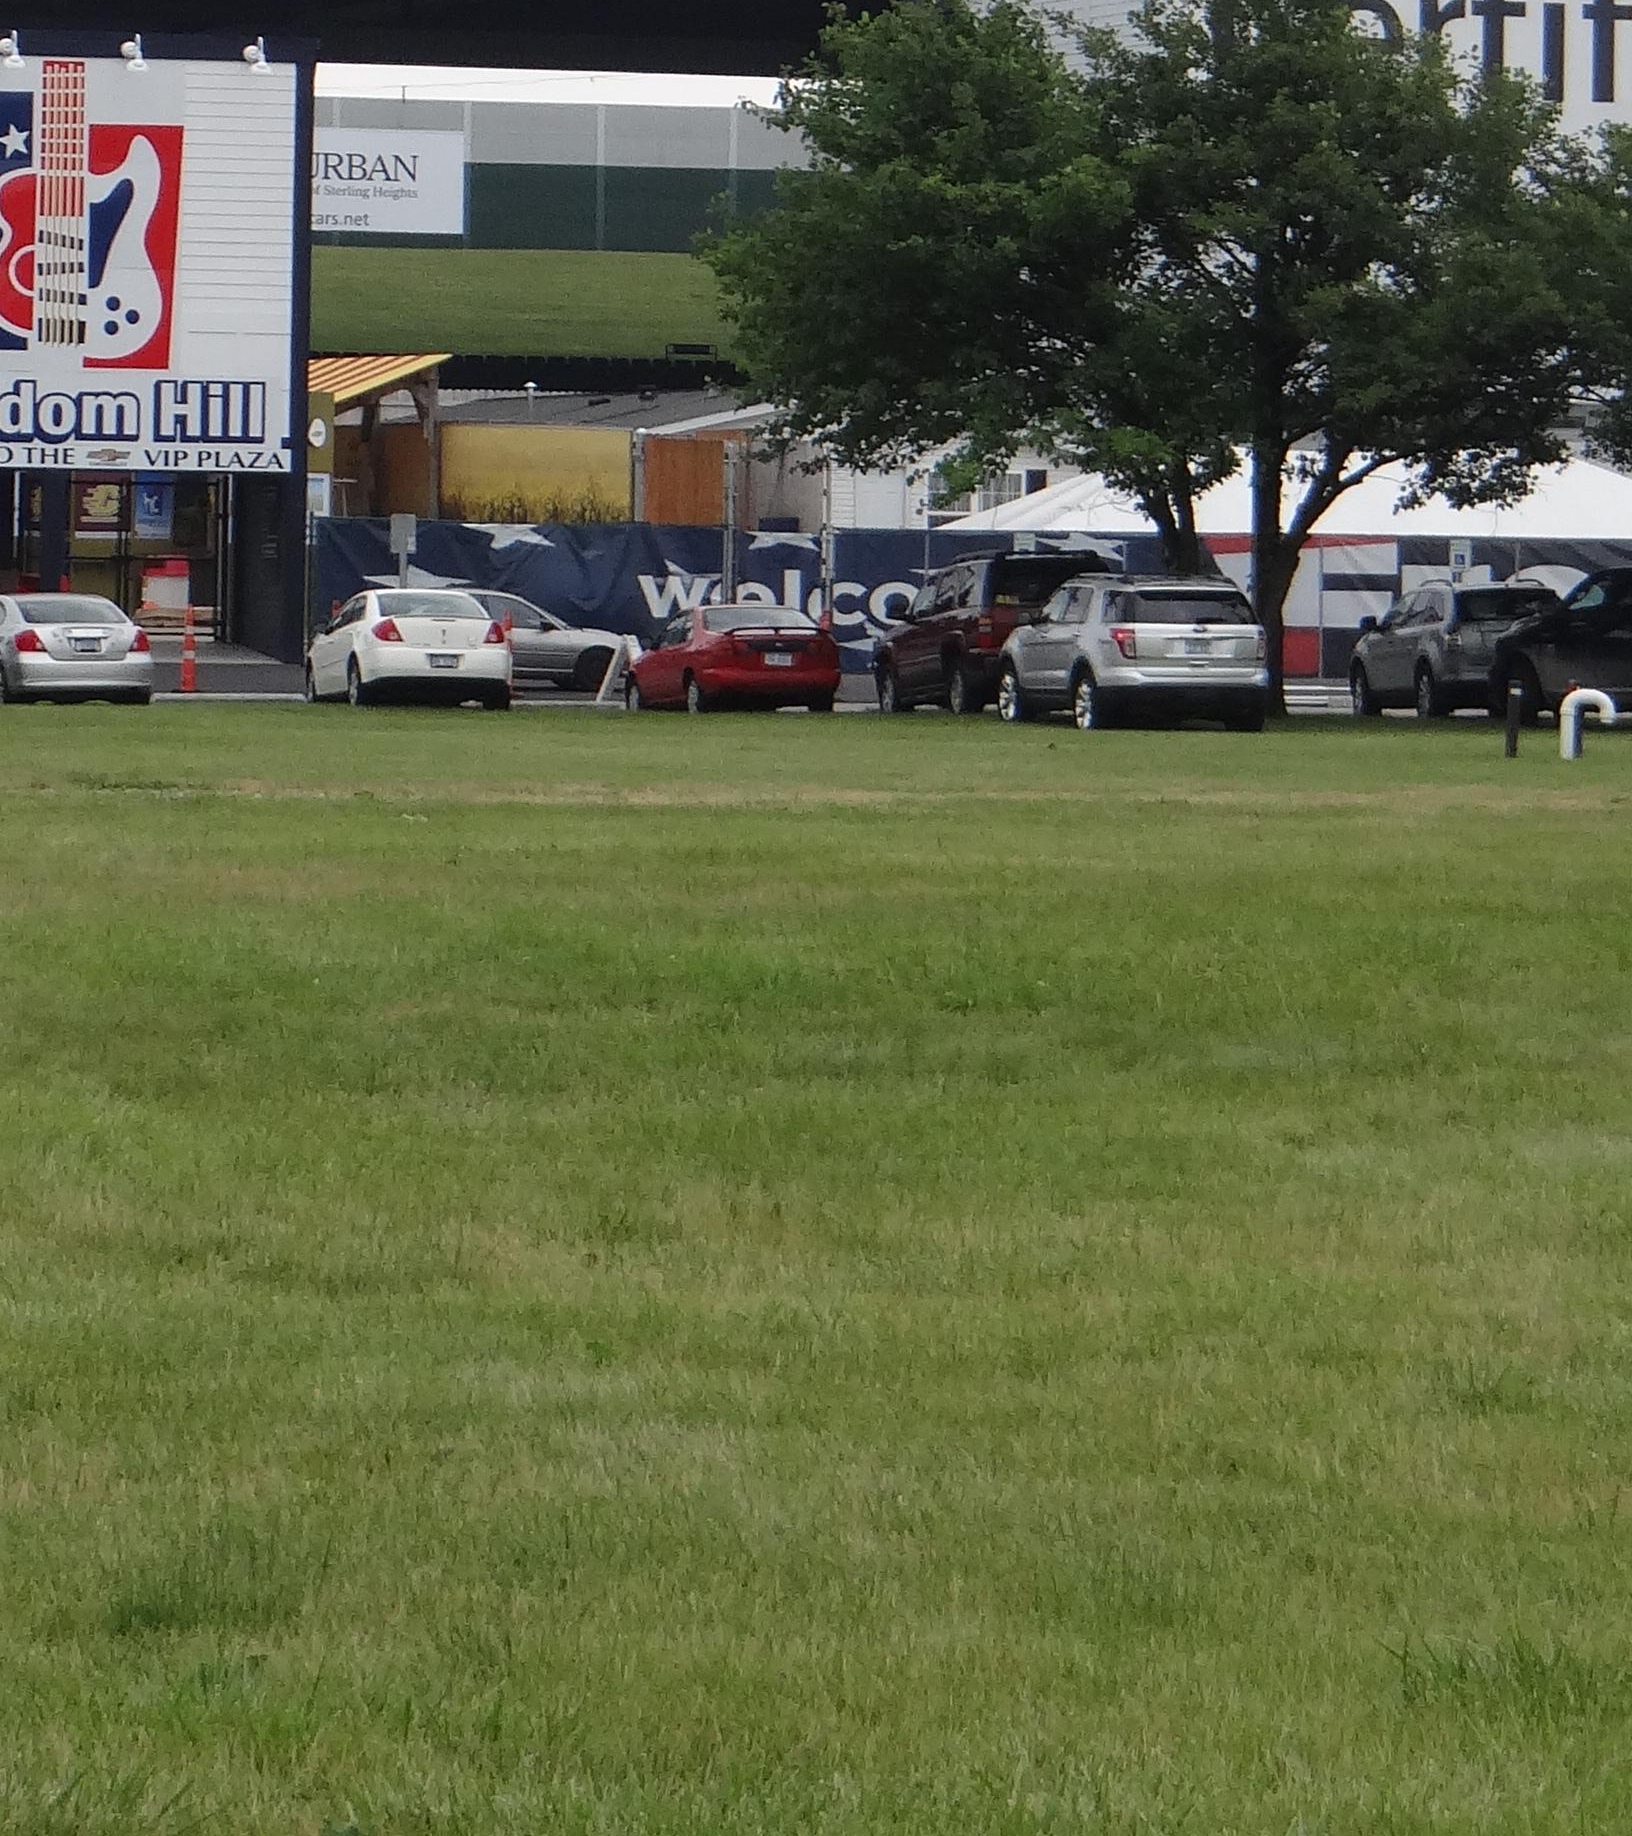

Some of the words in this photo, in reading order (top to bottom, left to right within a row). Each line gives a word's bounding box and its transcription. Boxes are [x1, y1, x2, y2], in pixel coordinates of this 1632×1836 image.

[323, 185, 371, 200] Sterling
[372, 186, 419, 201] Heights
[154, 379, 266, 444] Hill
[22, 447, 75, 465] THE
[143, 449, 189, 468] VIP
[197, 450, 285, 470] PLAZA
